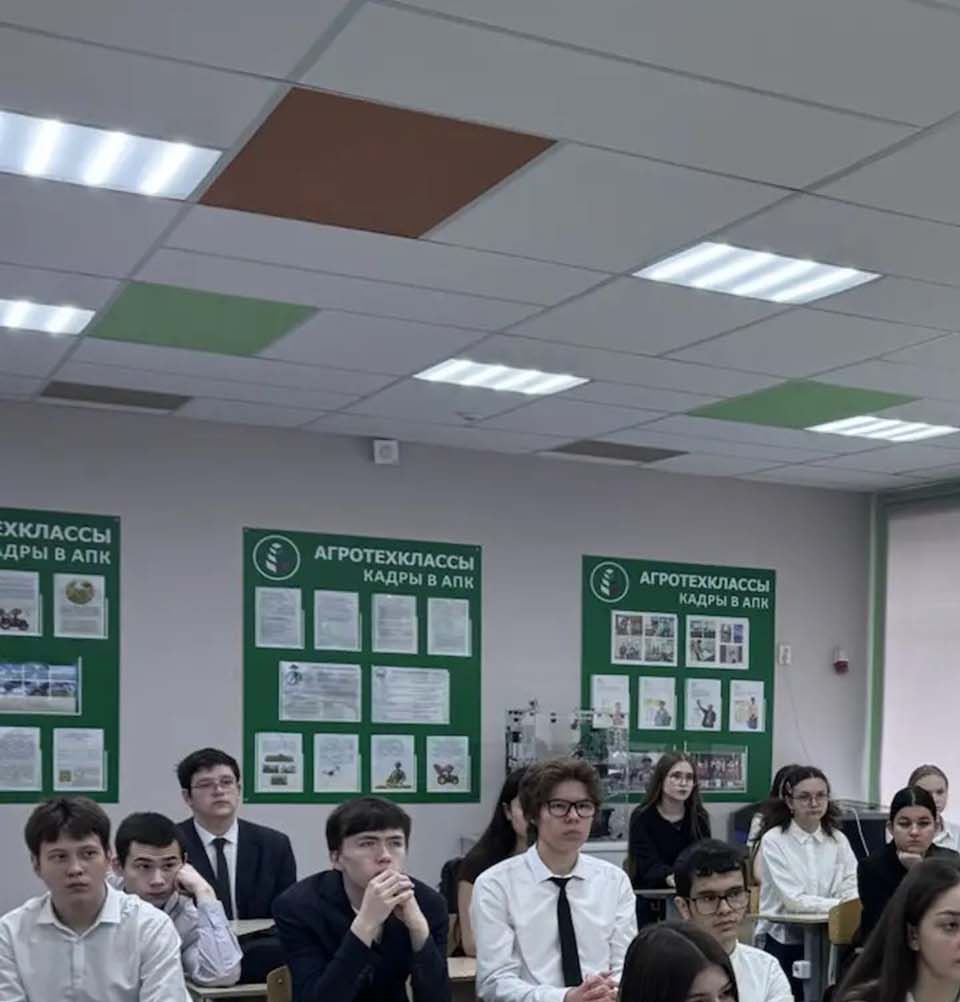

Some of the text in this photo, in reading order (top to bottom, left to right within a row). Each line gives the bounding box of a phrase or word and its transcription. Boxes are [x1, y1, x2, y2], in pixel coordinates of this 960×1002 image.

[0, 543, 111, 565] ДРЫ В АПК
[314, 545, 474, 570] АГРОТЕХКЛАССЫ
[363, 569, 474, 589] КАДРЫ В АПК
[639, 571, 770, 593] АГРОТЕХКЛАССЫ
[679, 592, 769, 609] КАДРЫ В АПК
